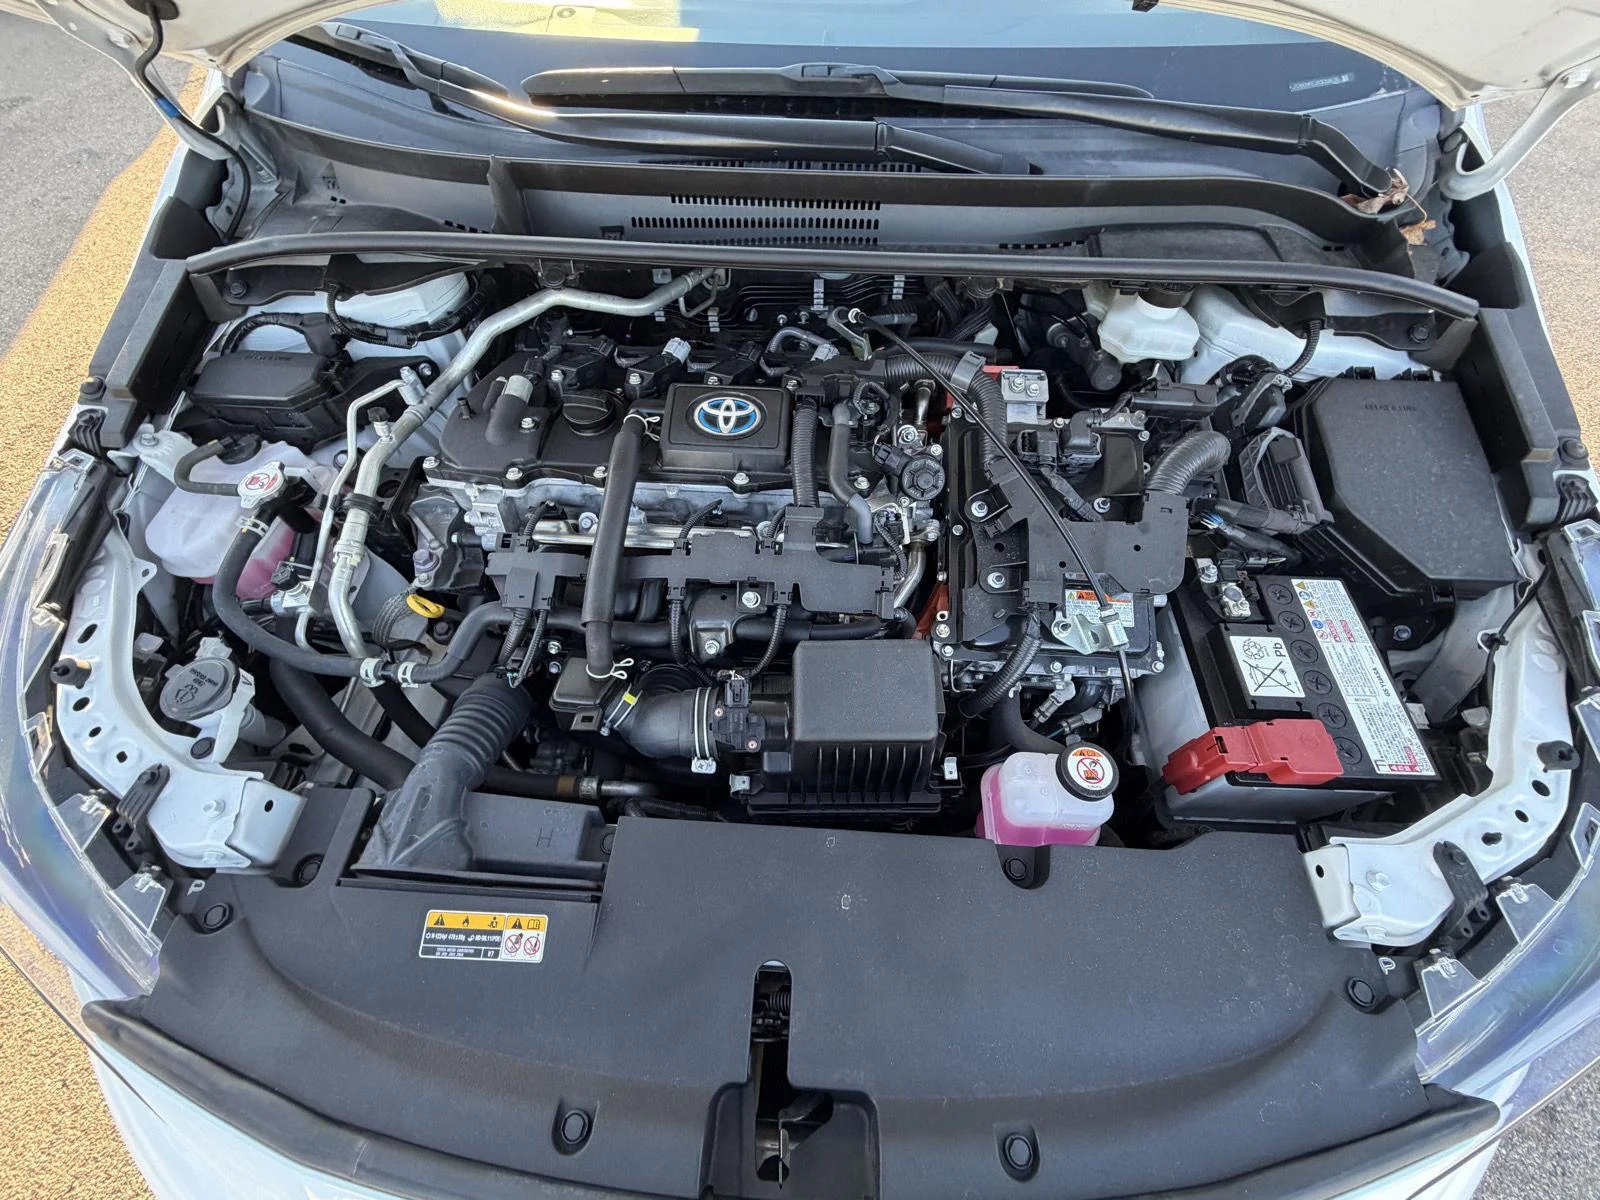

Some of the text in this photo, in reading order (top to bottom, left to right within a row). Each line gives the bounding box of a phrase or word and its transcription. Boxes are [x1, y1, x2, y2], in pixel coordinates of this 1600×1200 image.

[1273, 642, 1286, 657] Pb
[1372, 667, 1390, 697] GS YUASA
